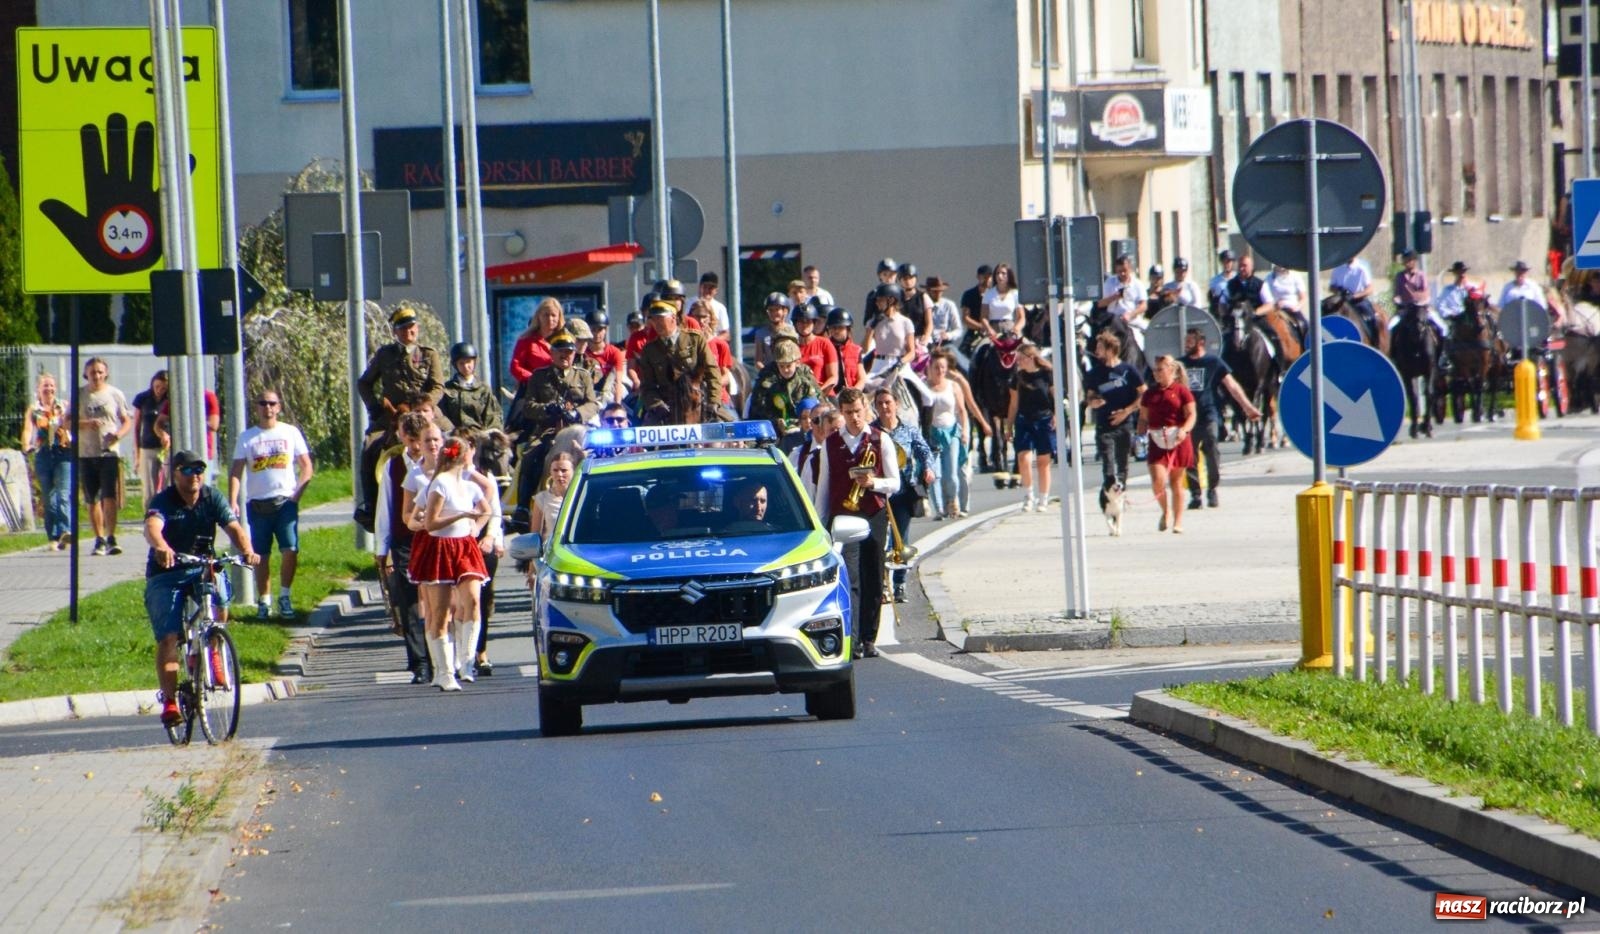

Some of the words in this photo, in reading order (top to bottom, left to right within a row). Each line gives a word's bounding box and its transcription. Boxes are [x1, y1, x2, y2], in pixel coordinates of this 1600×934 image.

[403, 160, 542, 185] RACORSKI
[551, 157, 637, 180] BARBER
[639, 427, 699, 443] POLICJA
[631, 548, 748, 563] POLICJA
[659, 627, 691, 644] HPP
[696, 624, 737, 642] R203
